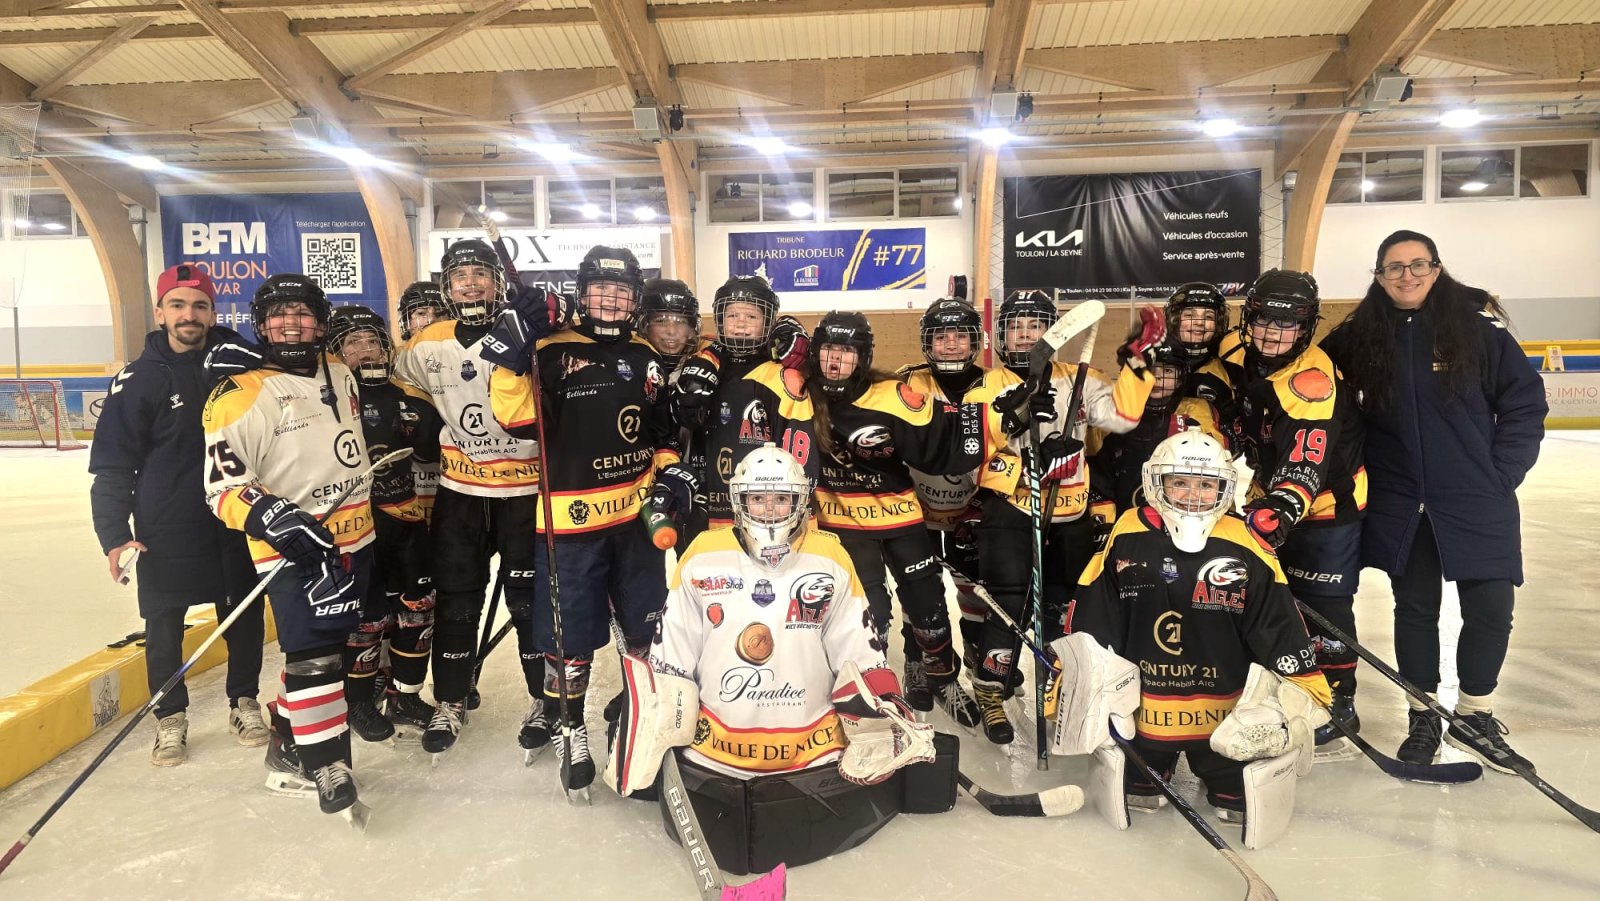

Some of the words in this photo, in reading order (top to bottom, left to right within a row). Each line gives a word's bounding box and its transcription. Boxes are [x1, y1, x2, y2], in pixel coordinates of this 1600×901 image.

[1163, 211, 1203, 220] Véhicules
[1204, 210, 1229, 220] neufs
[182, 222, 267, 255] BFM
[776, 236, 805, 244] TRIBUNE
[1163, 231, 1203, 240] Véhicules
[1204, 230, 1248, 240] d'occasion
[738, 249, 787, 260] RICHARD
[790, 248, 845, 259] BRODEUR
[872, 244, 923, 266] #77
[1016, 250, 1044, 258] TOULON
[1163, 252, 1193, 260] Service
[1194, 250, 1245, 262] après-vente
[184, 260, 268, 280] OULON
[212, 283, 241, 296] VAR
[682, 366, 718, 385] BAUE
[1558, 387, 1598, 398] IMMO
[623, 416, 640, 434] 21
[342, 438, 360, 460] 21
[782, 428, 810, 467] 18
[1290, 428, 1327, 464] 19
[207, 440, 246, 484] 75
[592, 494, 634, 516] VILLE
[818, 500, 856, 518] VILLE
[856, 506, 878, 519] DE
[881, 500, 915, 516] NICE
[509, 570, 536, 578] CC
[904, 556, 934, 574] CCM
[1288, 566, 1344, 584] BAUER
[1140, 660, 1198, 677] CENTURY
[719, 666, 807, 704] Paradice
[1198, 680, 1215, 688] AIG
[757, 700, 807, 708] RESTAURANT
[1140, 710, 1173, 726] ILLE
[1178, 711, 1200, 726] DE
[1205, 710, 1231, 726] NI
[711, 736, 758, 758] VILLE
[763, 744, 790, 760] DE
[795, 726, 834, 756] NICE
[668, 786, 716, 890] BAUER
